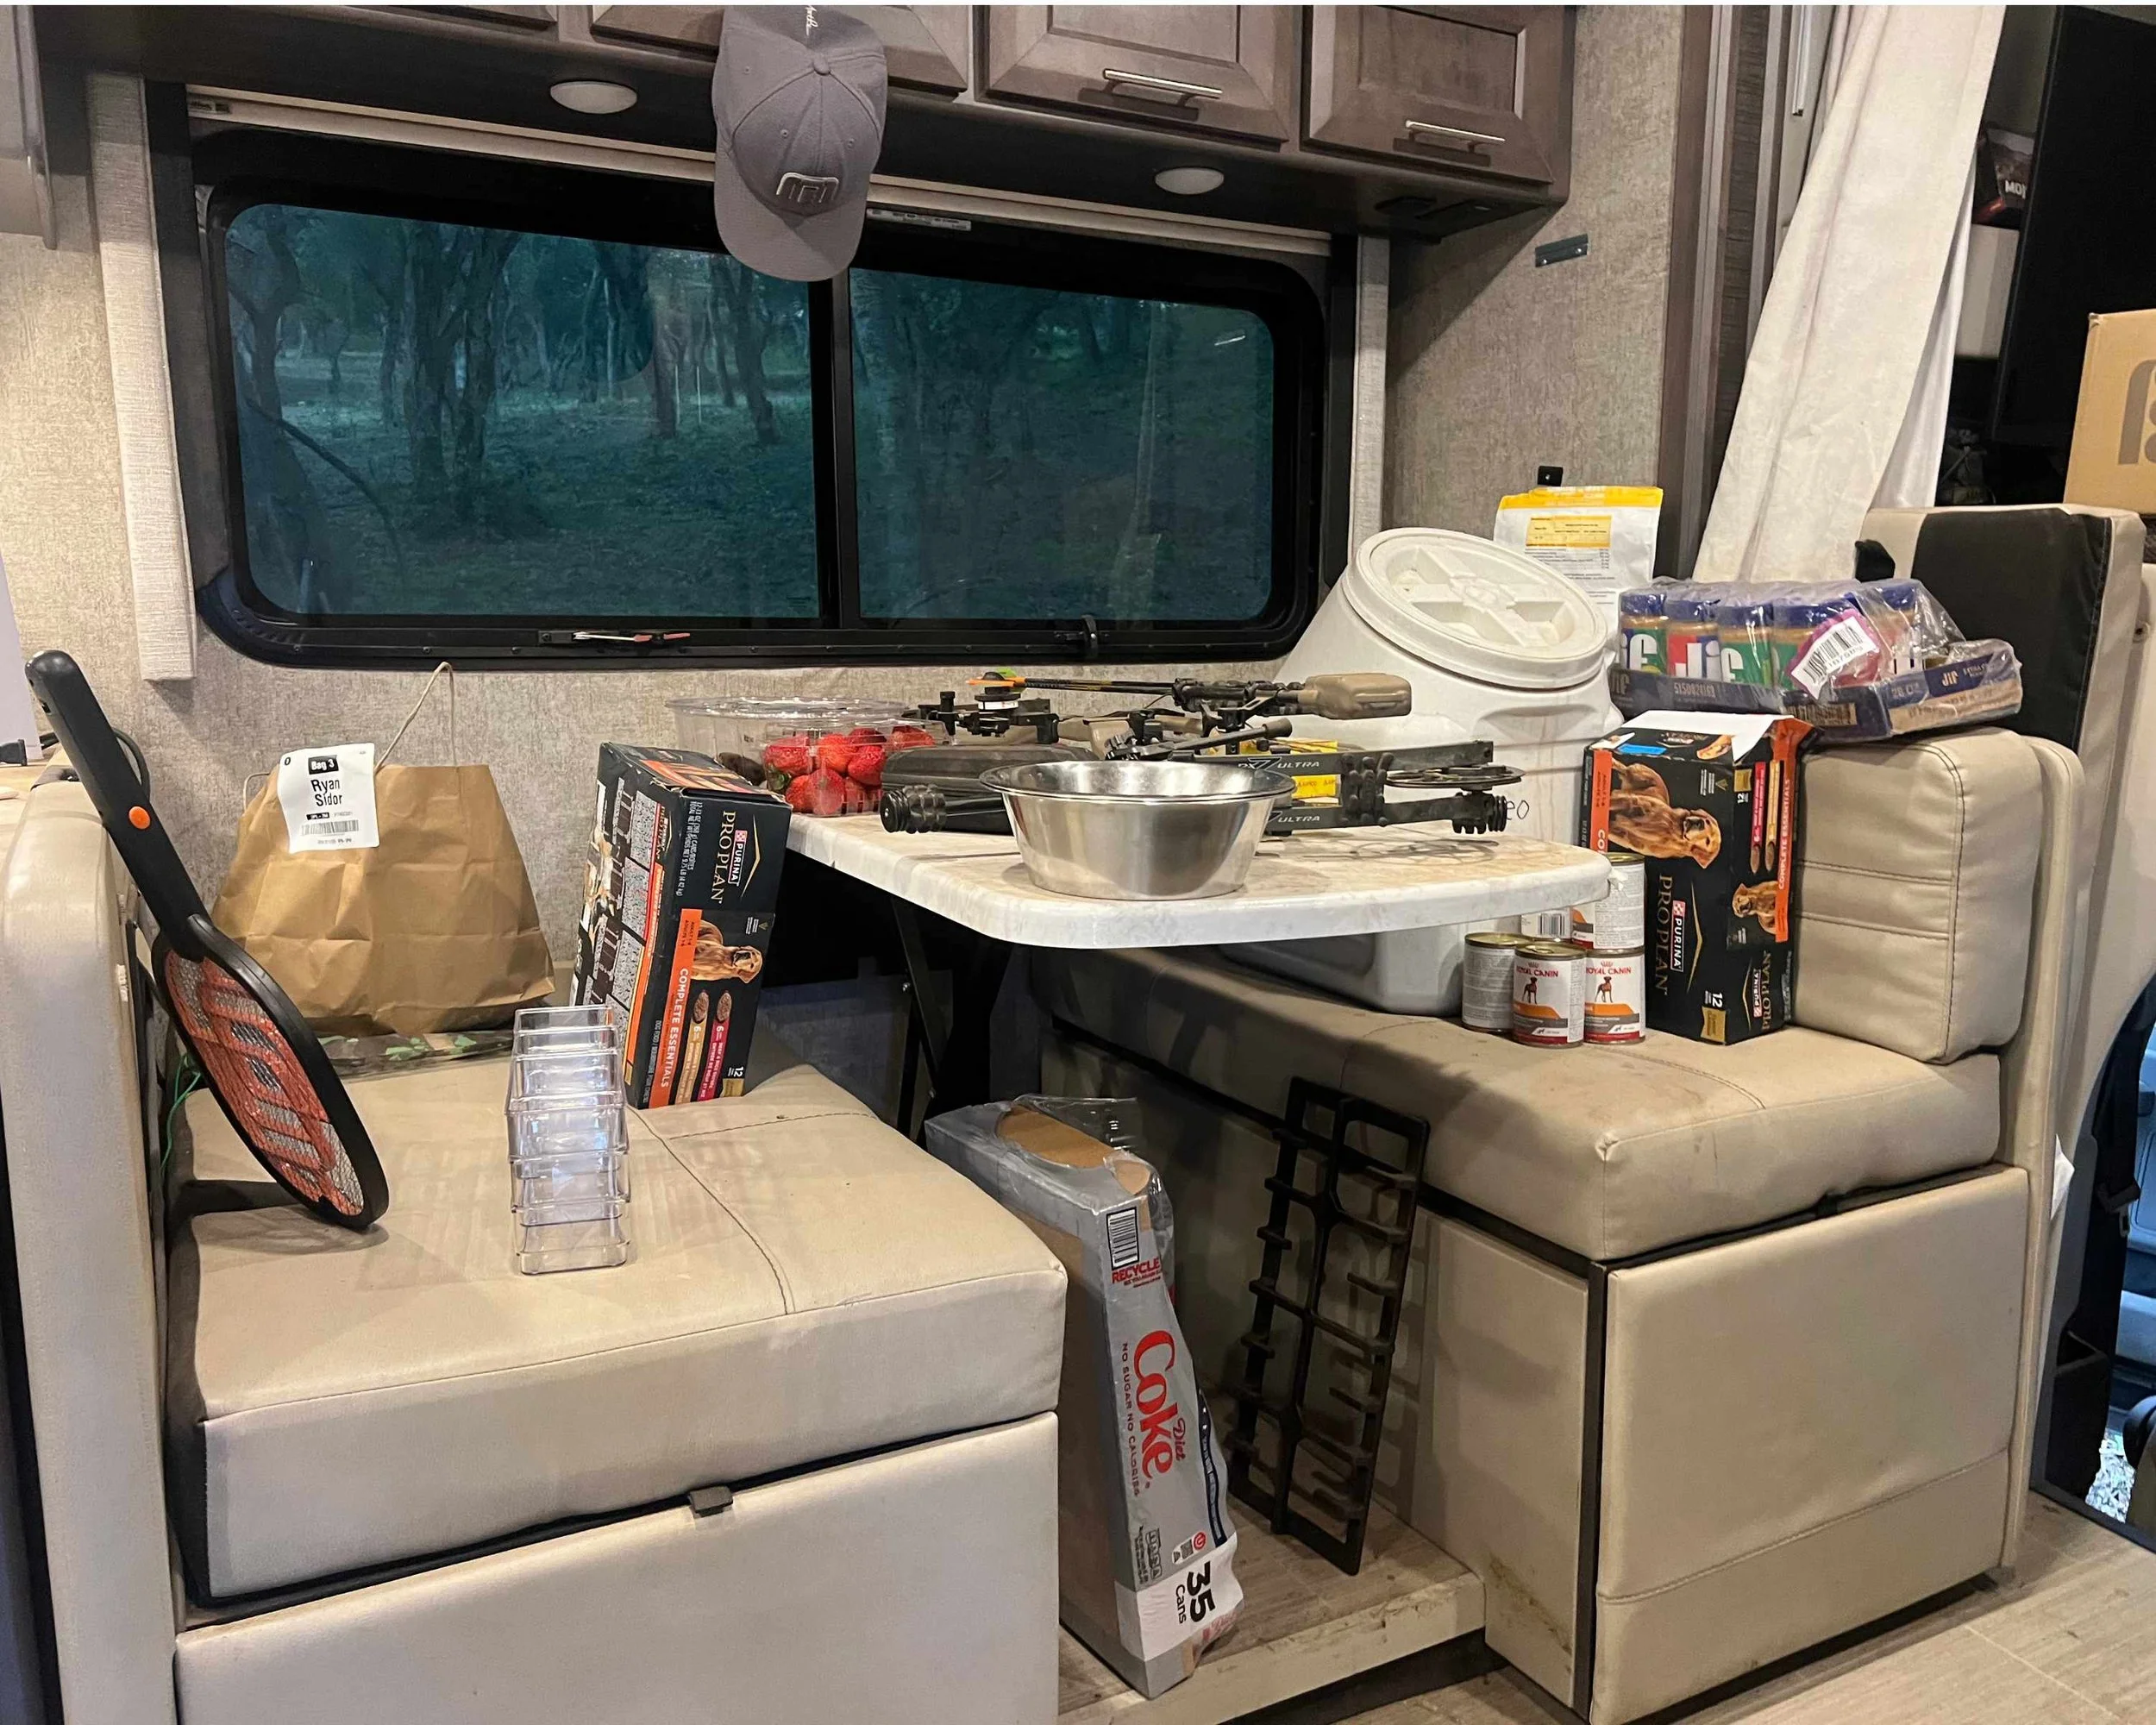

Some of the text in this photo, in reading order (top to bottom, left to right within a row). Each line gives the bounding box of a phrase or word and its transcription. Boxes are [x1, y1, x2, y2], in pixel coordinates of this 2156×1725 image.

[1675, 640, 1744, 682] Jif
[310, 758, 335, 771] Bag 3
[310, 779, 341, 796] Ryan
[315, 793, 343, 806] Sidor
[1777, 779, 1790, 890] COMPLETE ESSENTIALS
[711, 811, 736, 902] PRO PLAN
[730, 843, 743, 881] PURINA
[1655, 874, 1673, 992] PRO PLAN
[1674, 918, 1683, 968] PURINA
[1533, 969, 1558, 978] CANIN
[1608, 966, 1632, 975] CANIN
[1762, 952, 1771, 1030] PRO PLAN
[1712, 992, 1723, 1007] 12
[661, 968, 688, 1088] COMPLETE ESSENTIALS
[733, 1066, 743, 1077] 12
[1112, 1257, 1161, 1284] RECYCLE
[1121, 1342, 1140, 1497] NO SUGAR NO CALORIES
[1134, 1330, 1178, 1480] Coke
[1173, 1417, 1186, 1461] Diet
[1175, 1584, 1187, 1624] Cans
[1187, 1561, 1216, 1622] 35
